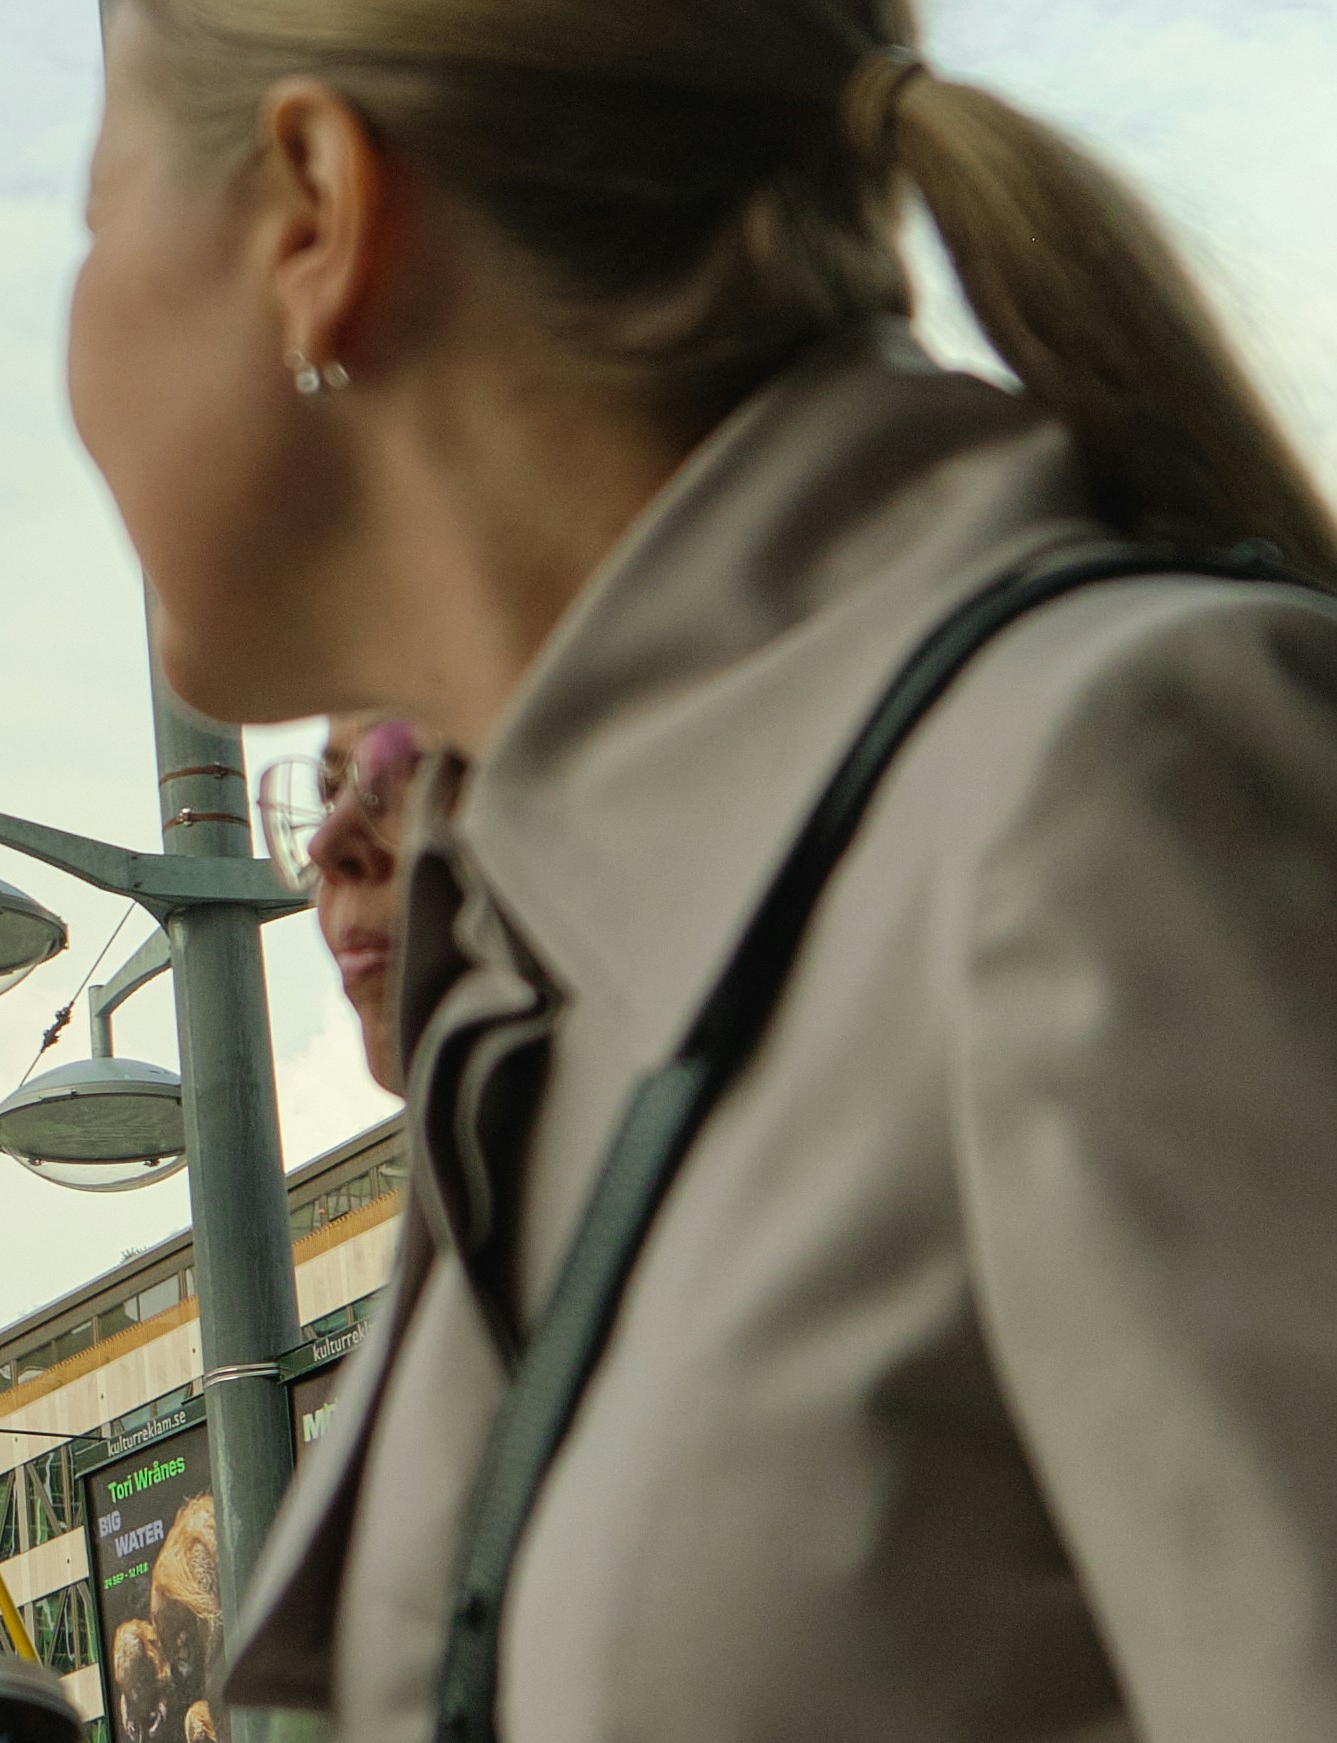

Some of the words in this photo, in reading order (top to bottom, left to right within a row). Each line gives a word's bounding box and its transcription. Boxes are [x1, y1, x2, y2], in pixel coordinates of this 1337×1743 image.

[312, 1320, 370, 1362] kulturrekl
[107, 1410, 187, 1457] kulturreklam.se
[107, 1474, 133, 1503] Tori
[135, 1457, 186, 1492] Wrånes
[98, 1510, 121, 1538] BIG
[114, 1520, 164, 1558] WATER
